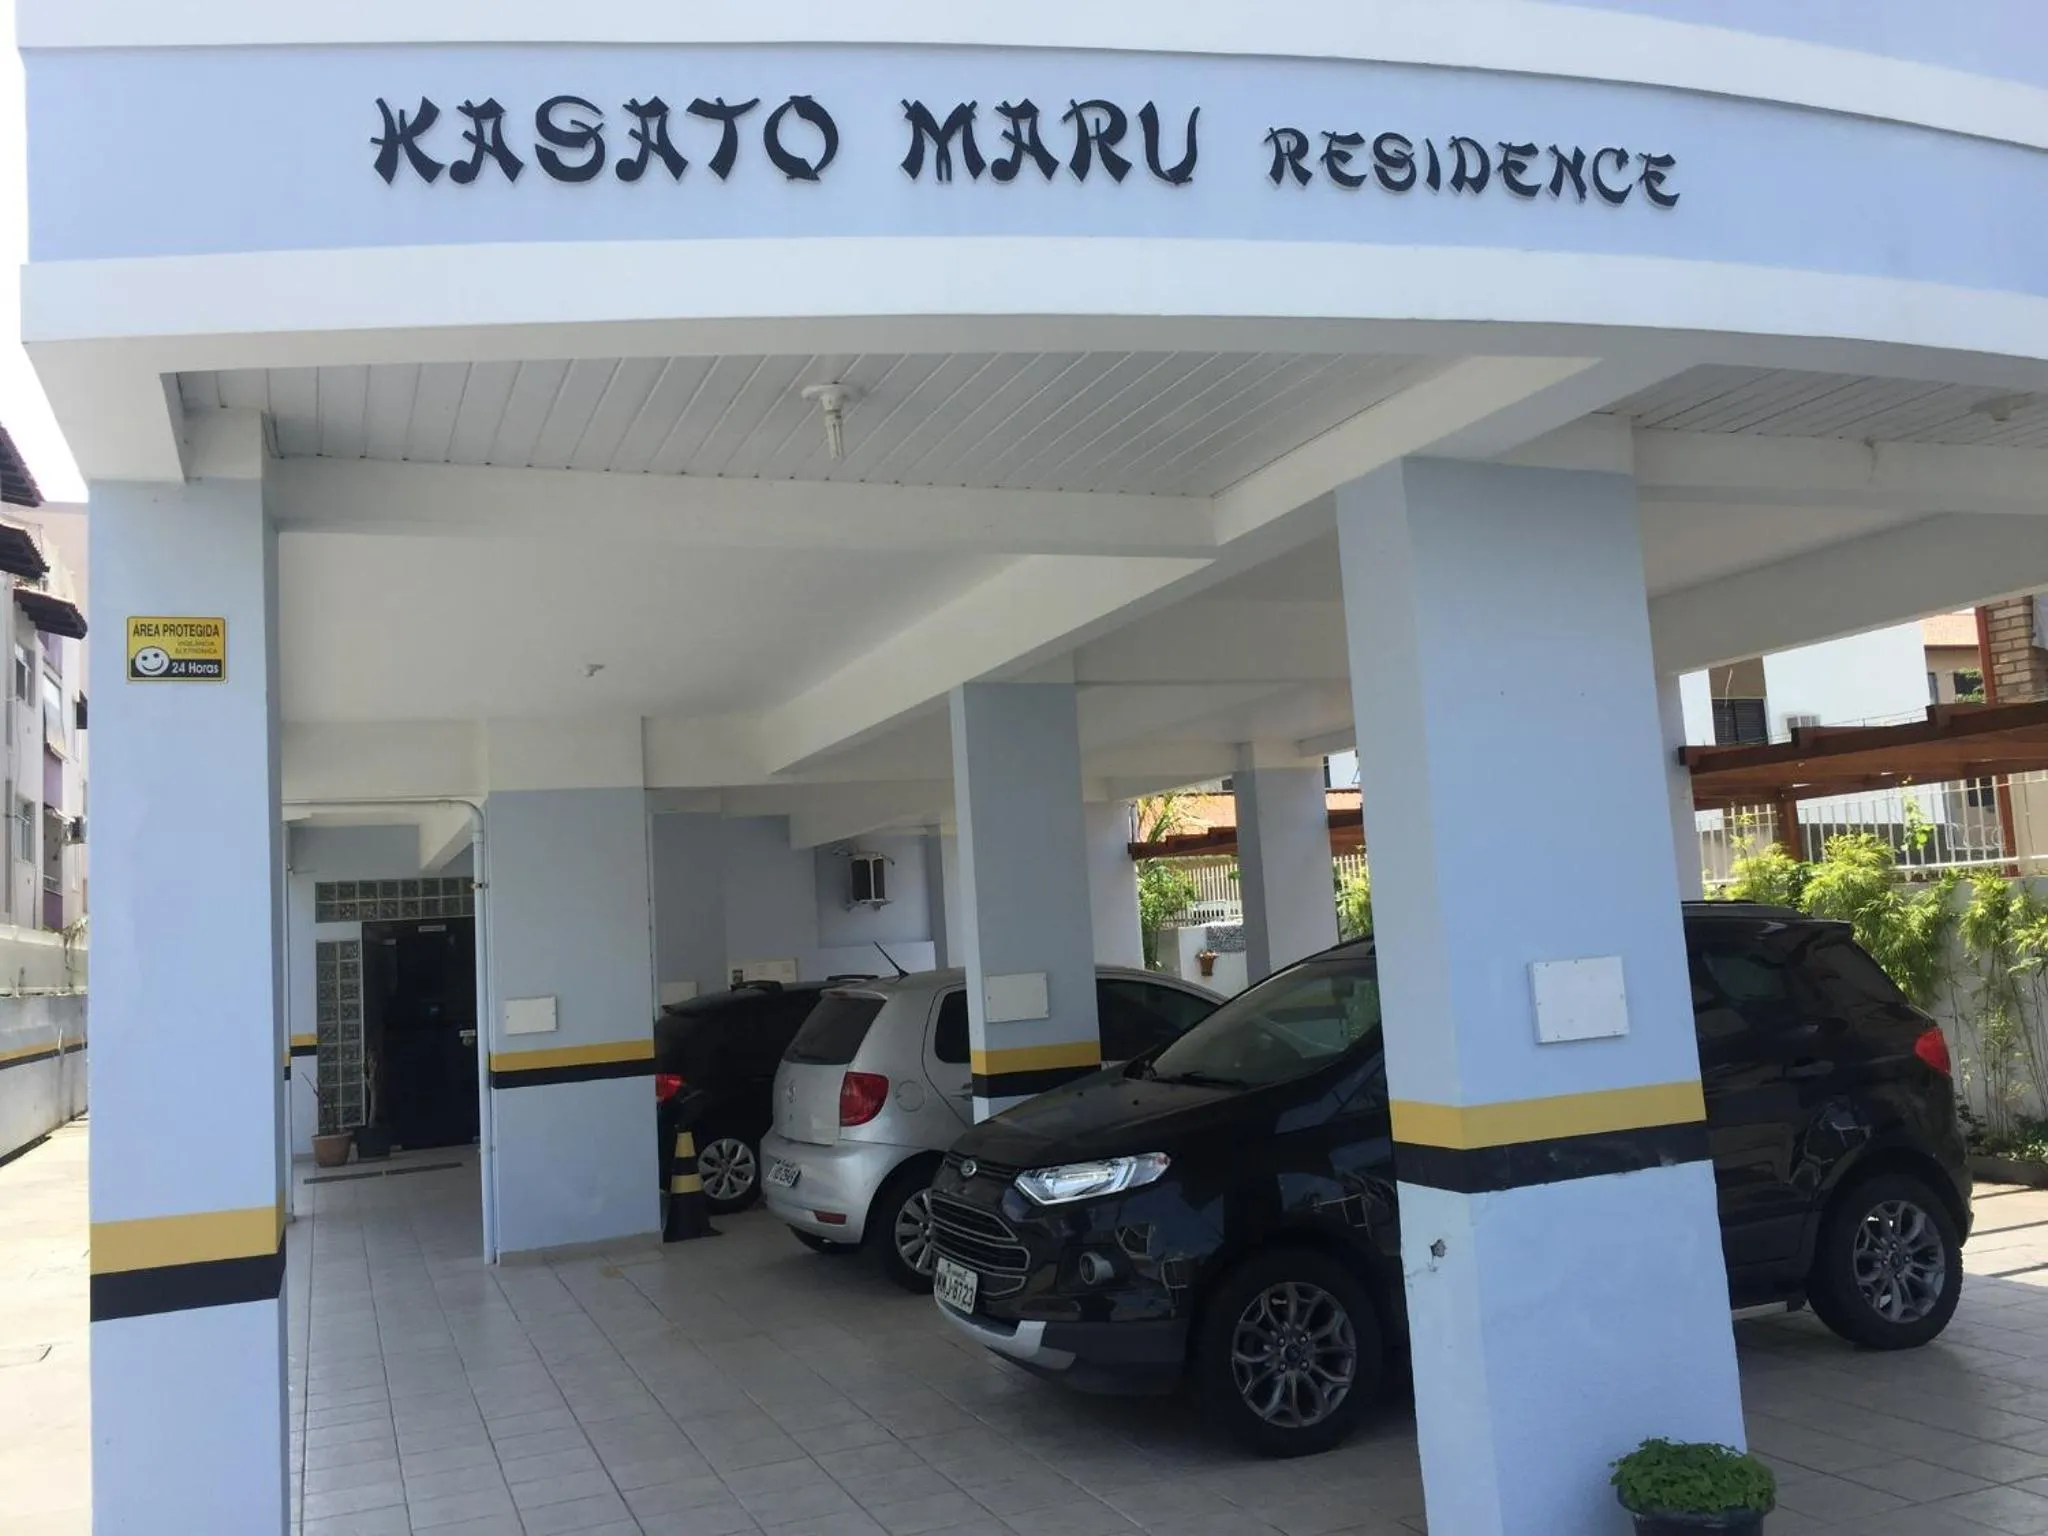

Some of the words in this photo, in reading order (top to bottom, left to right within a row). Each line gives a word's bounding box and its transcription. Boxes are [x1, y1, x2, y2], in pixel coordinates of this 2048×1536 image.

[370, 95, 839, 185] KASATO
[901, 98, 1200, 186] MARU
[1264, 127, 1680, 207] RESIDENCE
[133, 619, 160, 637] ÁREA
[162, 623, 220, 637] PROTEGIDA
[171, 661, 185, 674] 24
[188, 661, 220, 674] Horas
